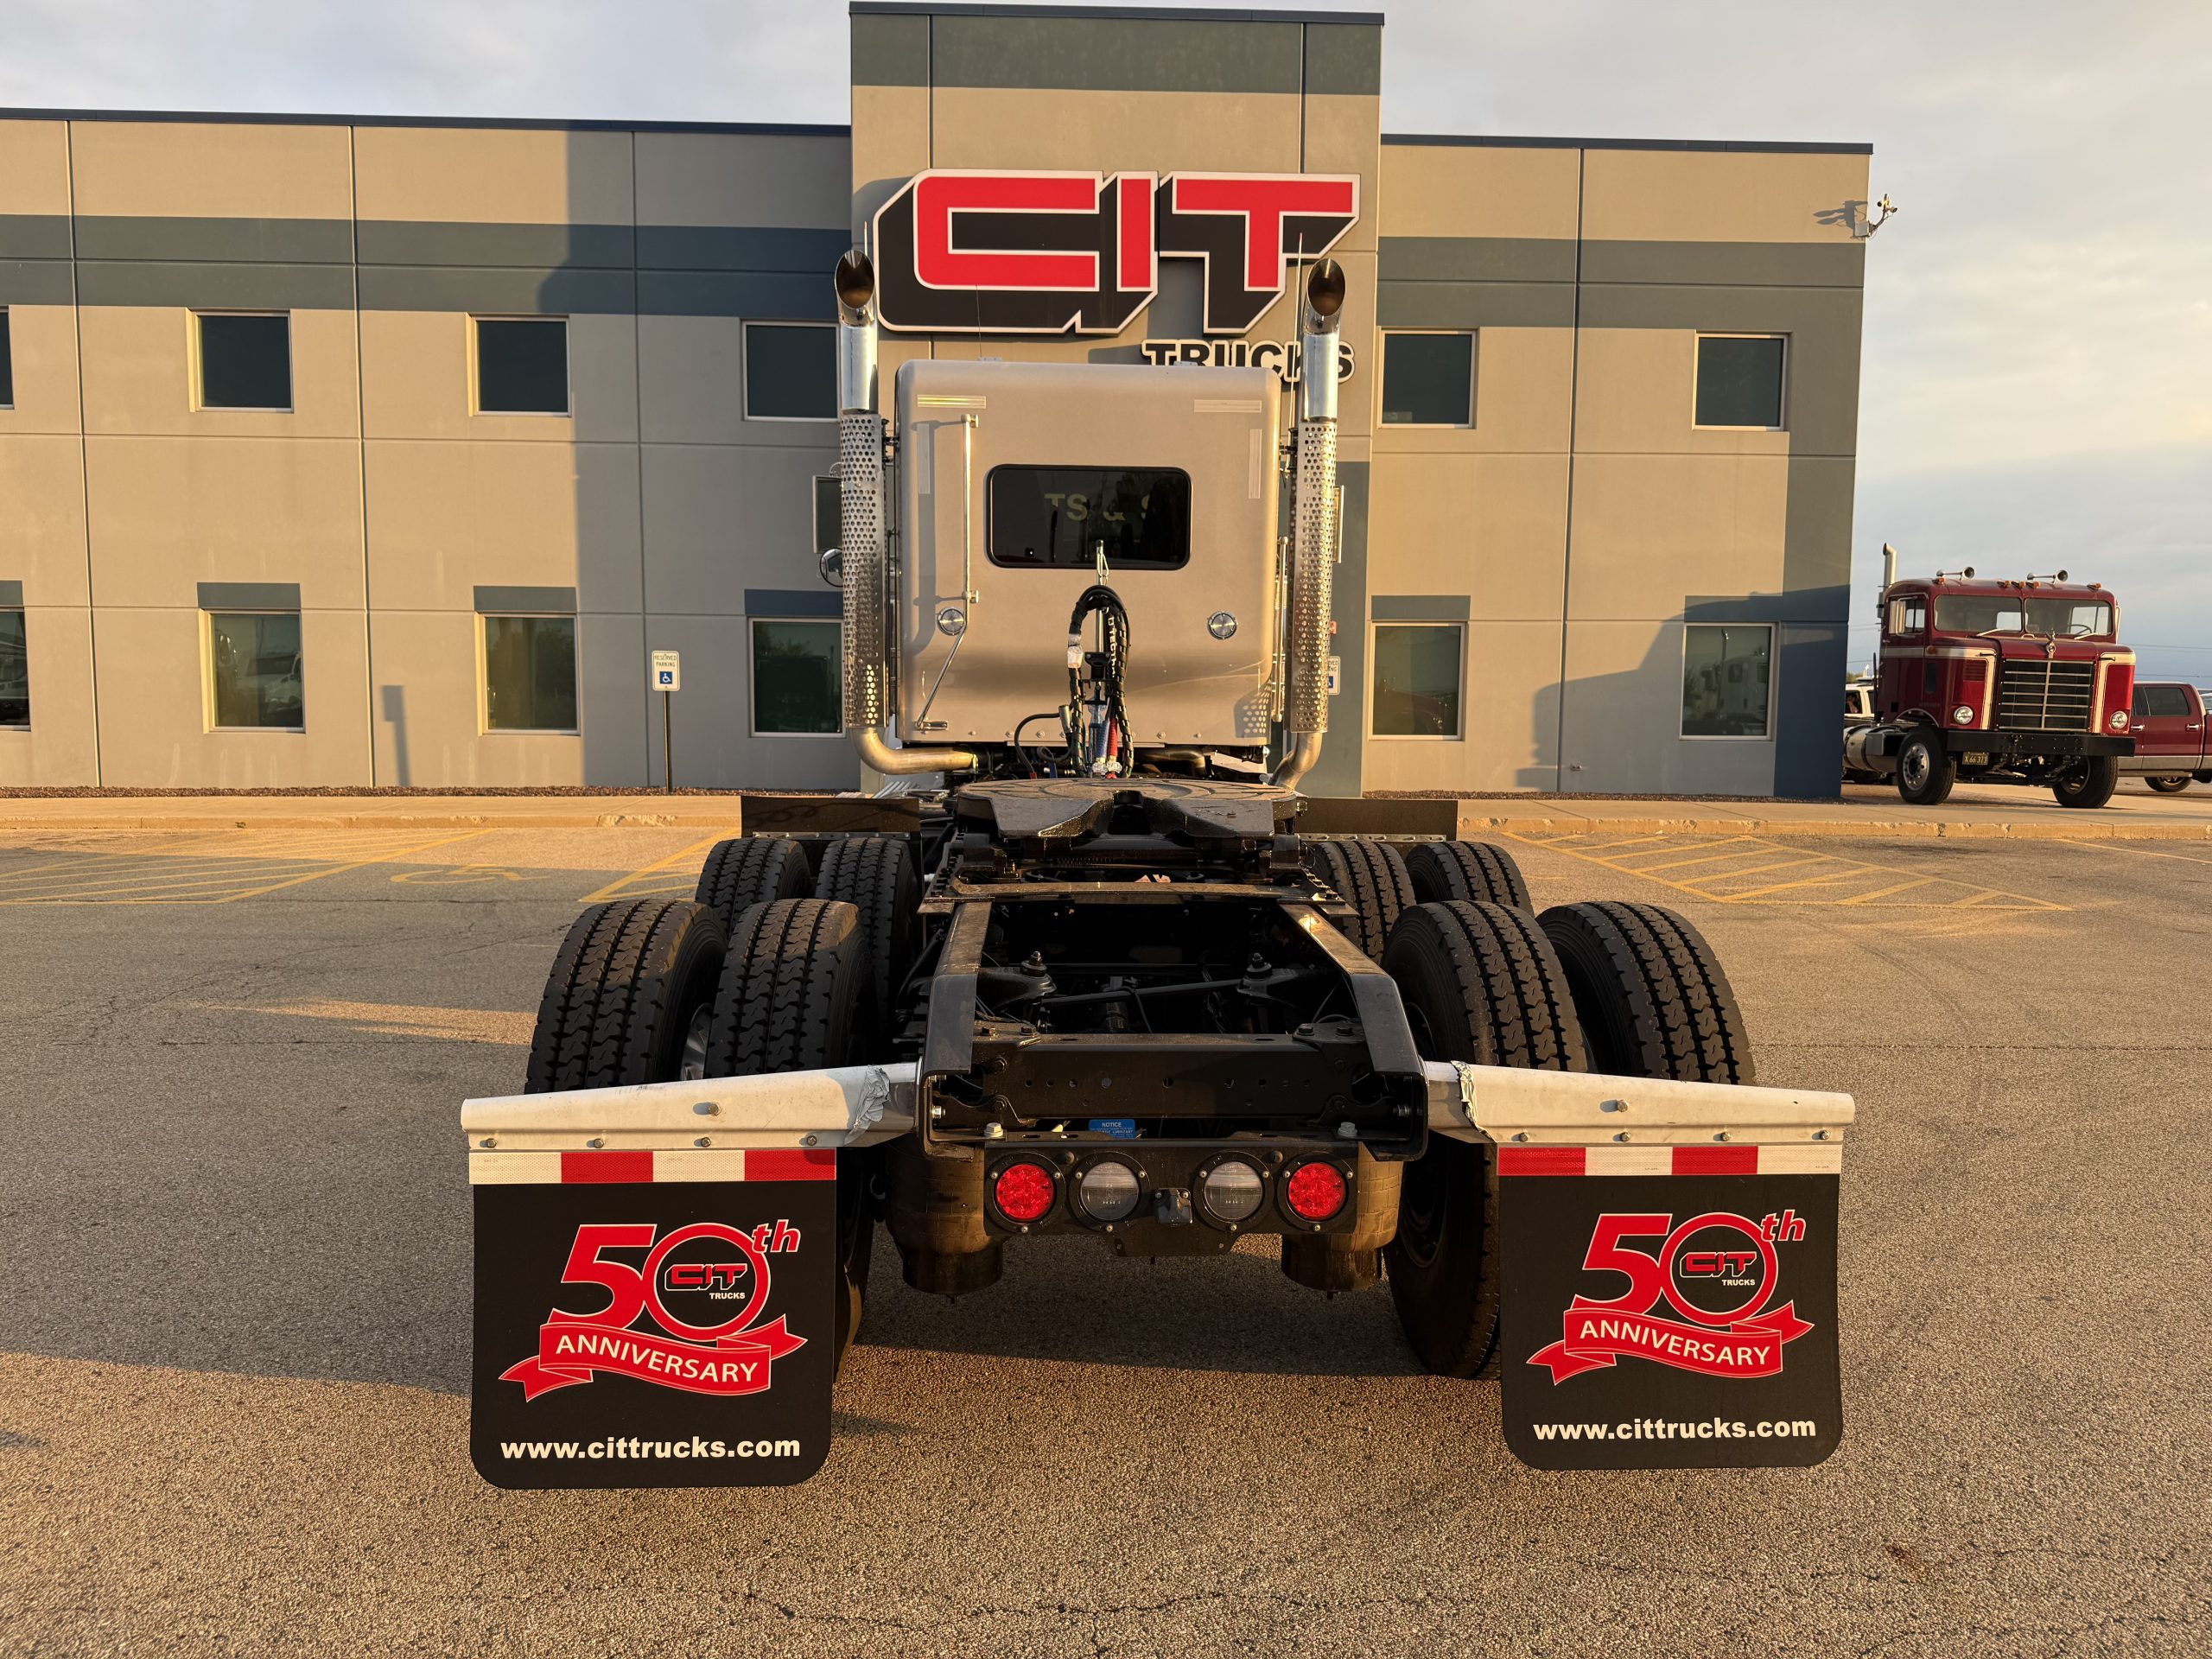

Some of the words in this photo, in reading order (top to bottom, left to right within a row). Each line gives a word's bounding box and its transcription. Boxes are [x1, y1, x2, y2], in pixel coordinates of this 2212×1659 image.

[874, 169, 1360, 334] CIT
[664, 1263, 747, 1291] CIT
[1680, 1251, 1757, 1278] CIT
[709, 1292, 746, 1300] TRUCKS
[1580, 1319, 1770, 1366] ANNIVERSARY
[556, 1335, 759, 1382] ANNIVERSARY
[1533, 1417, 1816, 1440] www.cittrucks.com
[500, 1436, 801, 1459] www.cittrucks.com
